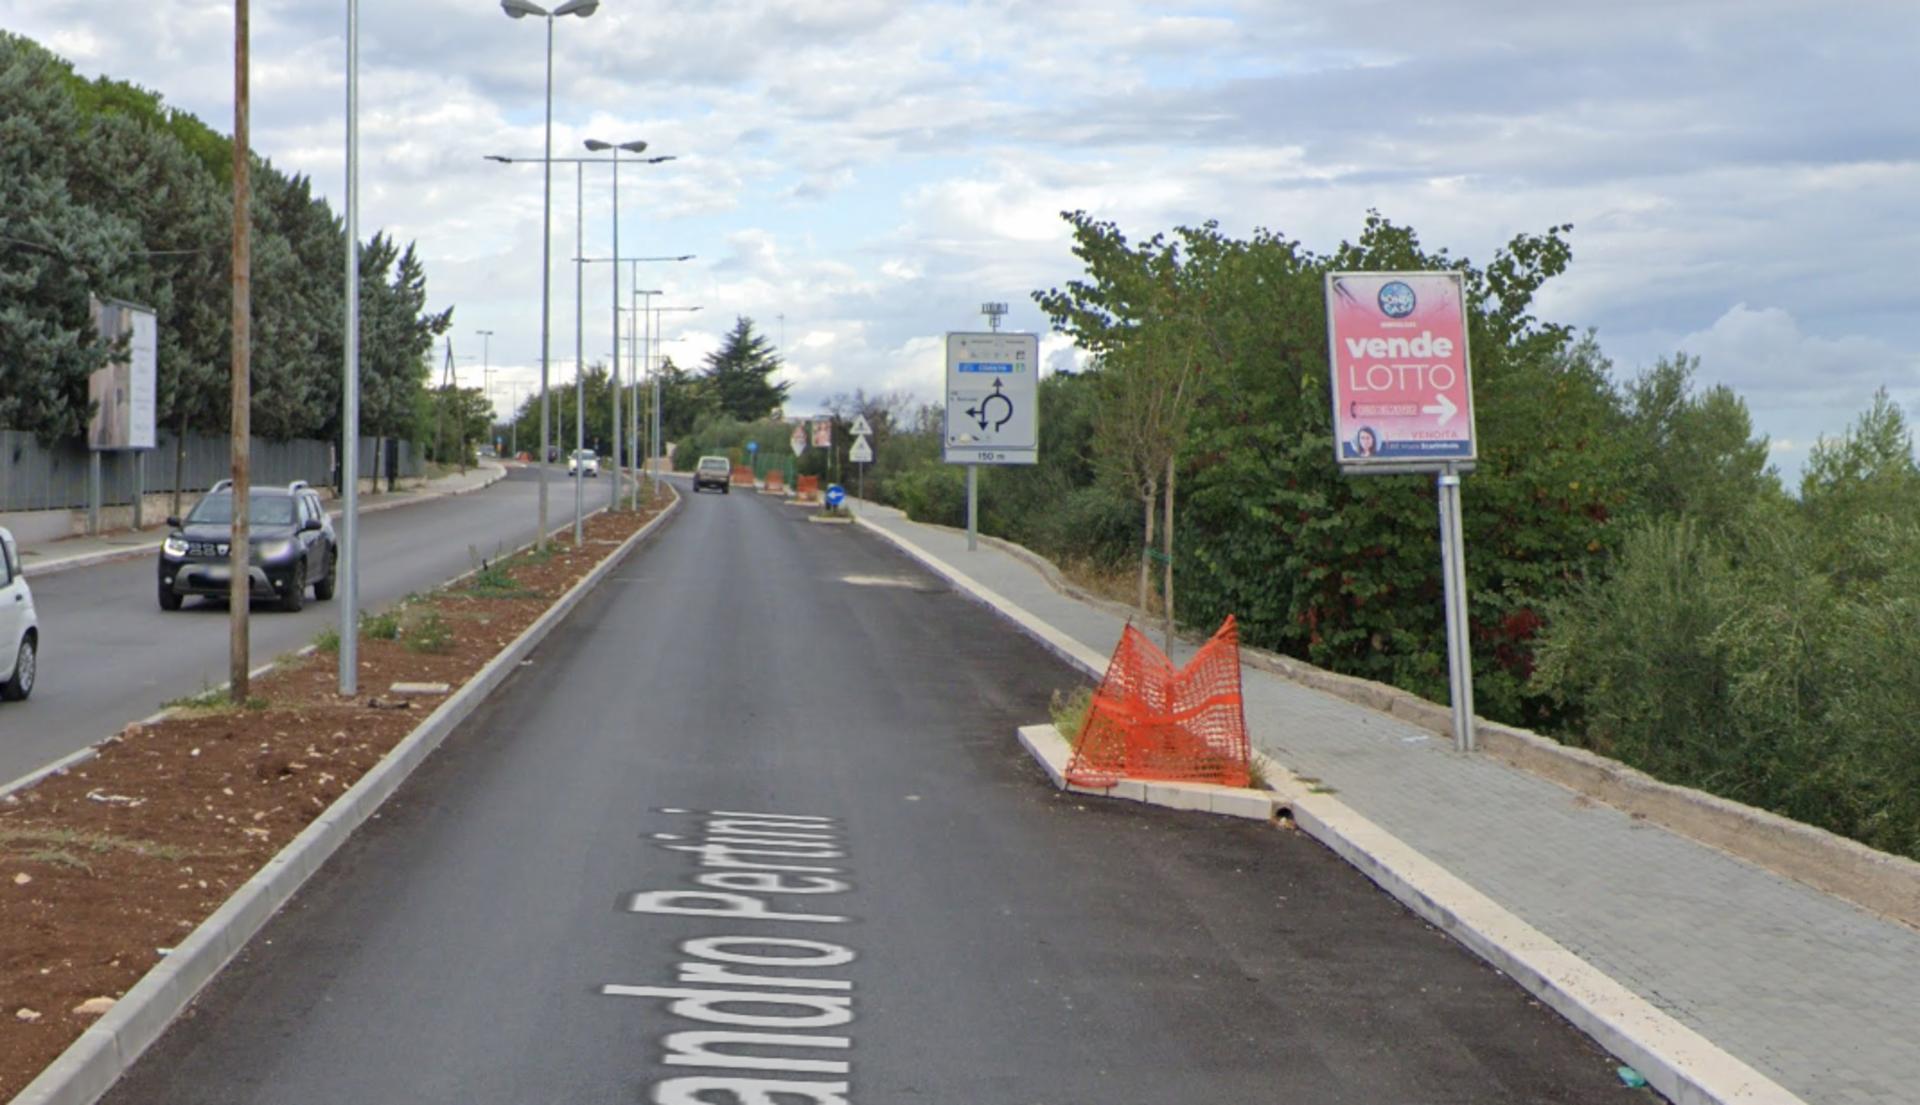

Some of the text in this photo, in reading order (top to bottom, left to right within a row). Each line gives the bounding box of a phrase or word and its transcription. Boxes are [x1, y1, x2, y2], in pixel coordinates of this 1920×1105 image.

[1346, 331, 1453, 358] vende
[1350, 364, 1456, 391] LOTTO
[1411, 430, 1458, 439] VENDITA
[978, 452, 994, 460] 150
